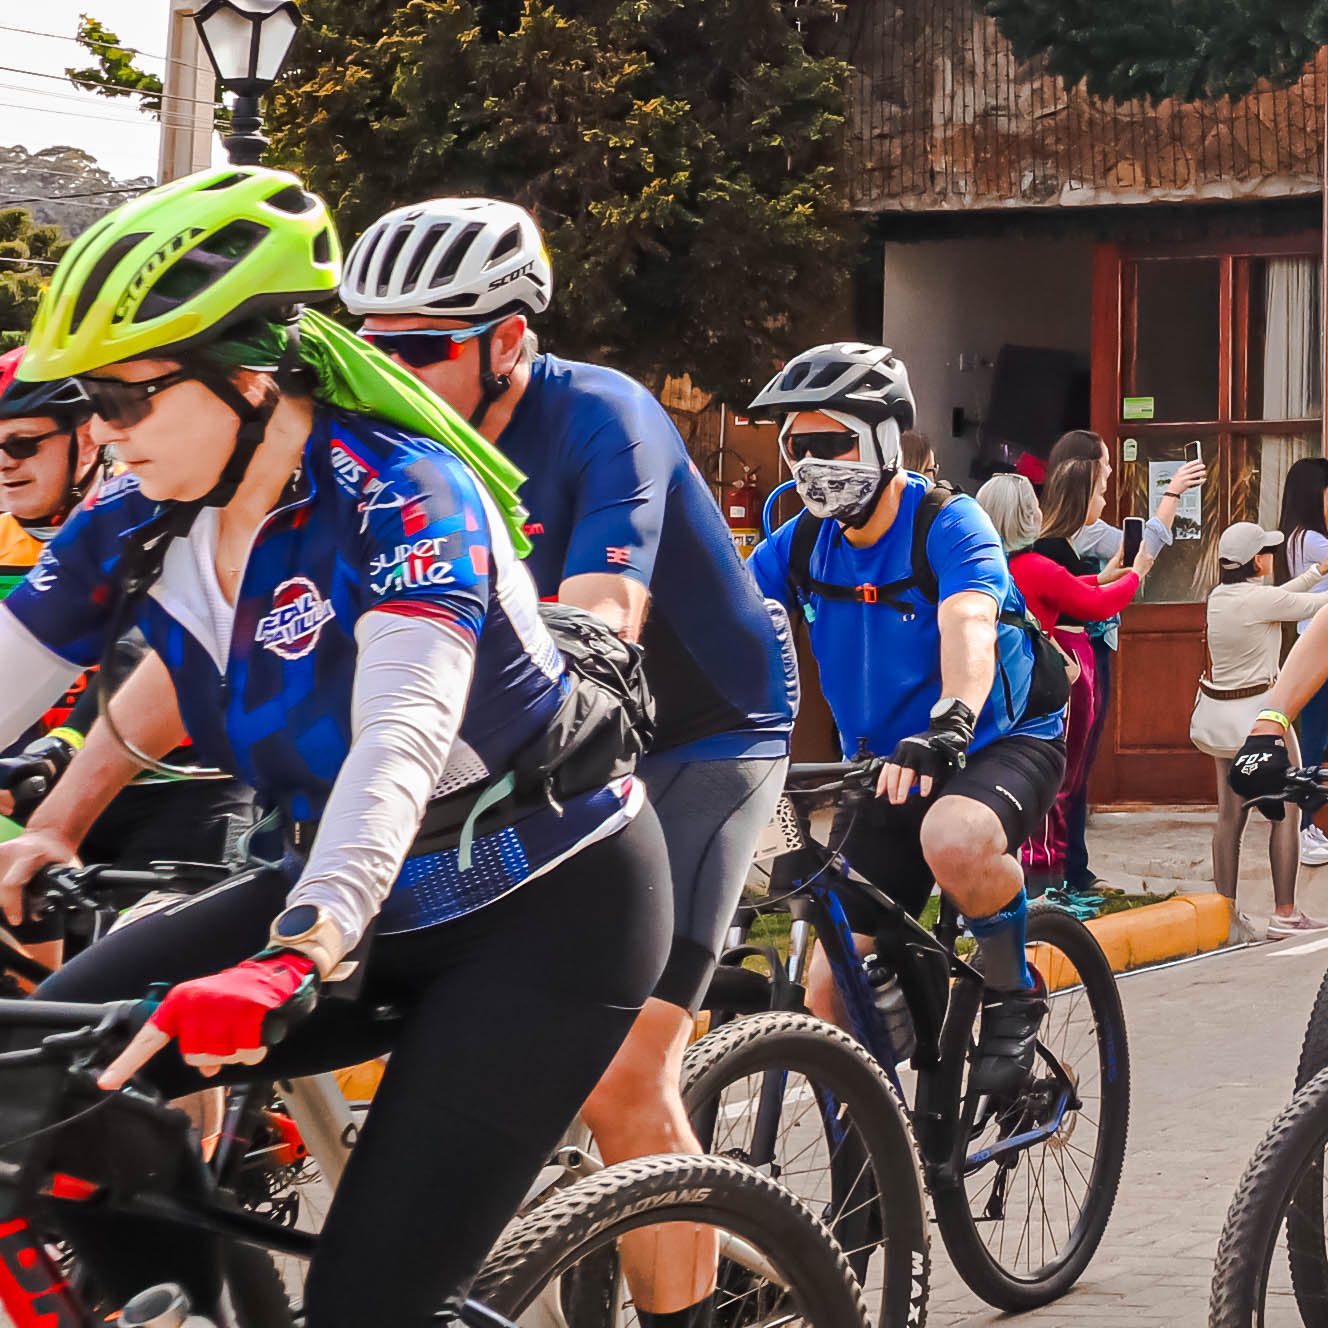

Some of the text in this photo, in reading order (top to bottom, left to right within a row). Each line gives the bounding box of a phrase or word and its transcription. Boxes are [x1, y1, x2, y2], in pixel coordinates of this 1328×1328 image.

[487, 259, 535, 293] SCOTT
[1235, 752, 1273, 767] FOX
[906, 1250, 924, 1328] MAX
